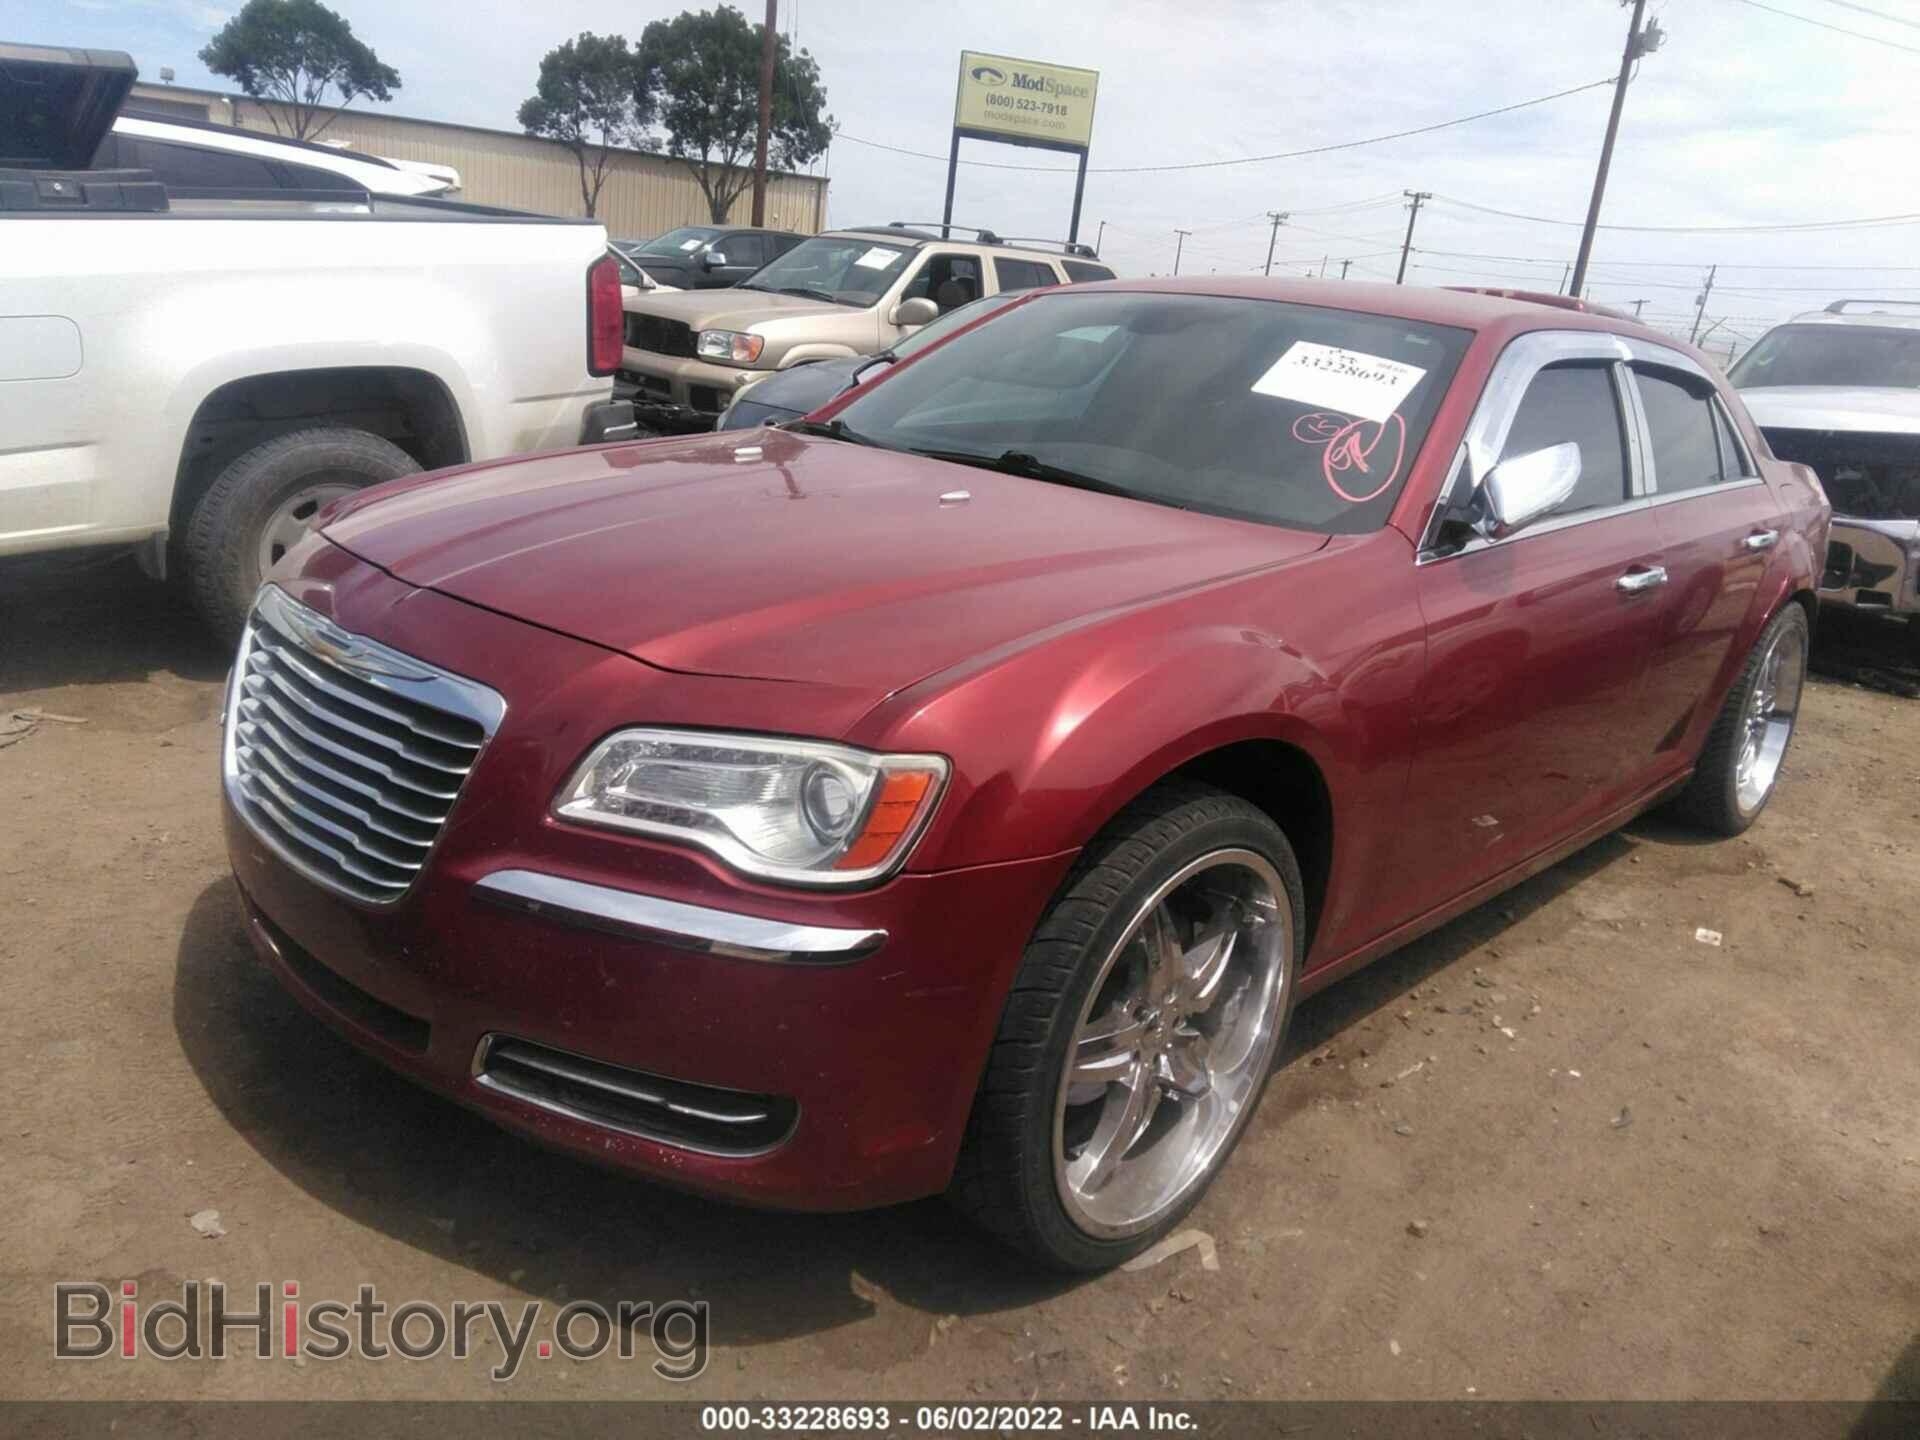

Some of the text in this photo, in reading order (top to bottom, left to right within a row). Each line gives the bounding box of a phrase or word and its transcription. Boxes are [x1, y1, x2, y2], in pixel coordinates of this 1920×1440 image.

[1012, 73, 1088, 98] ModSpace
[986, 93, 1067, 116] (800) 523-7918
[984, 111, 1065, 129] modspace.com
